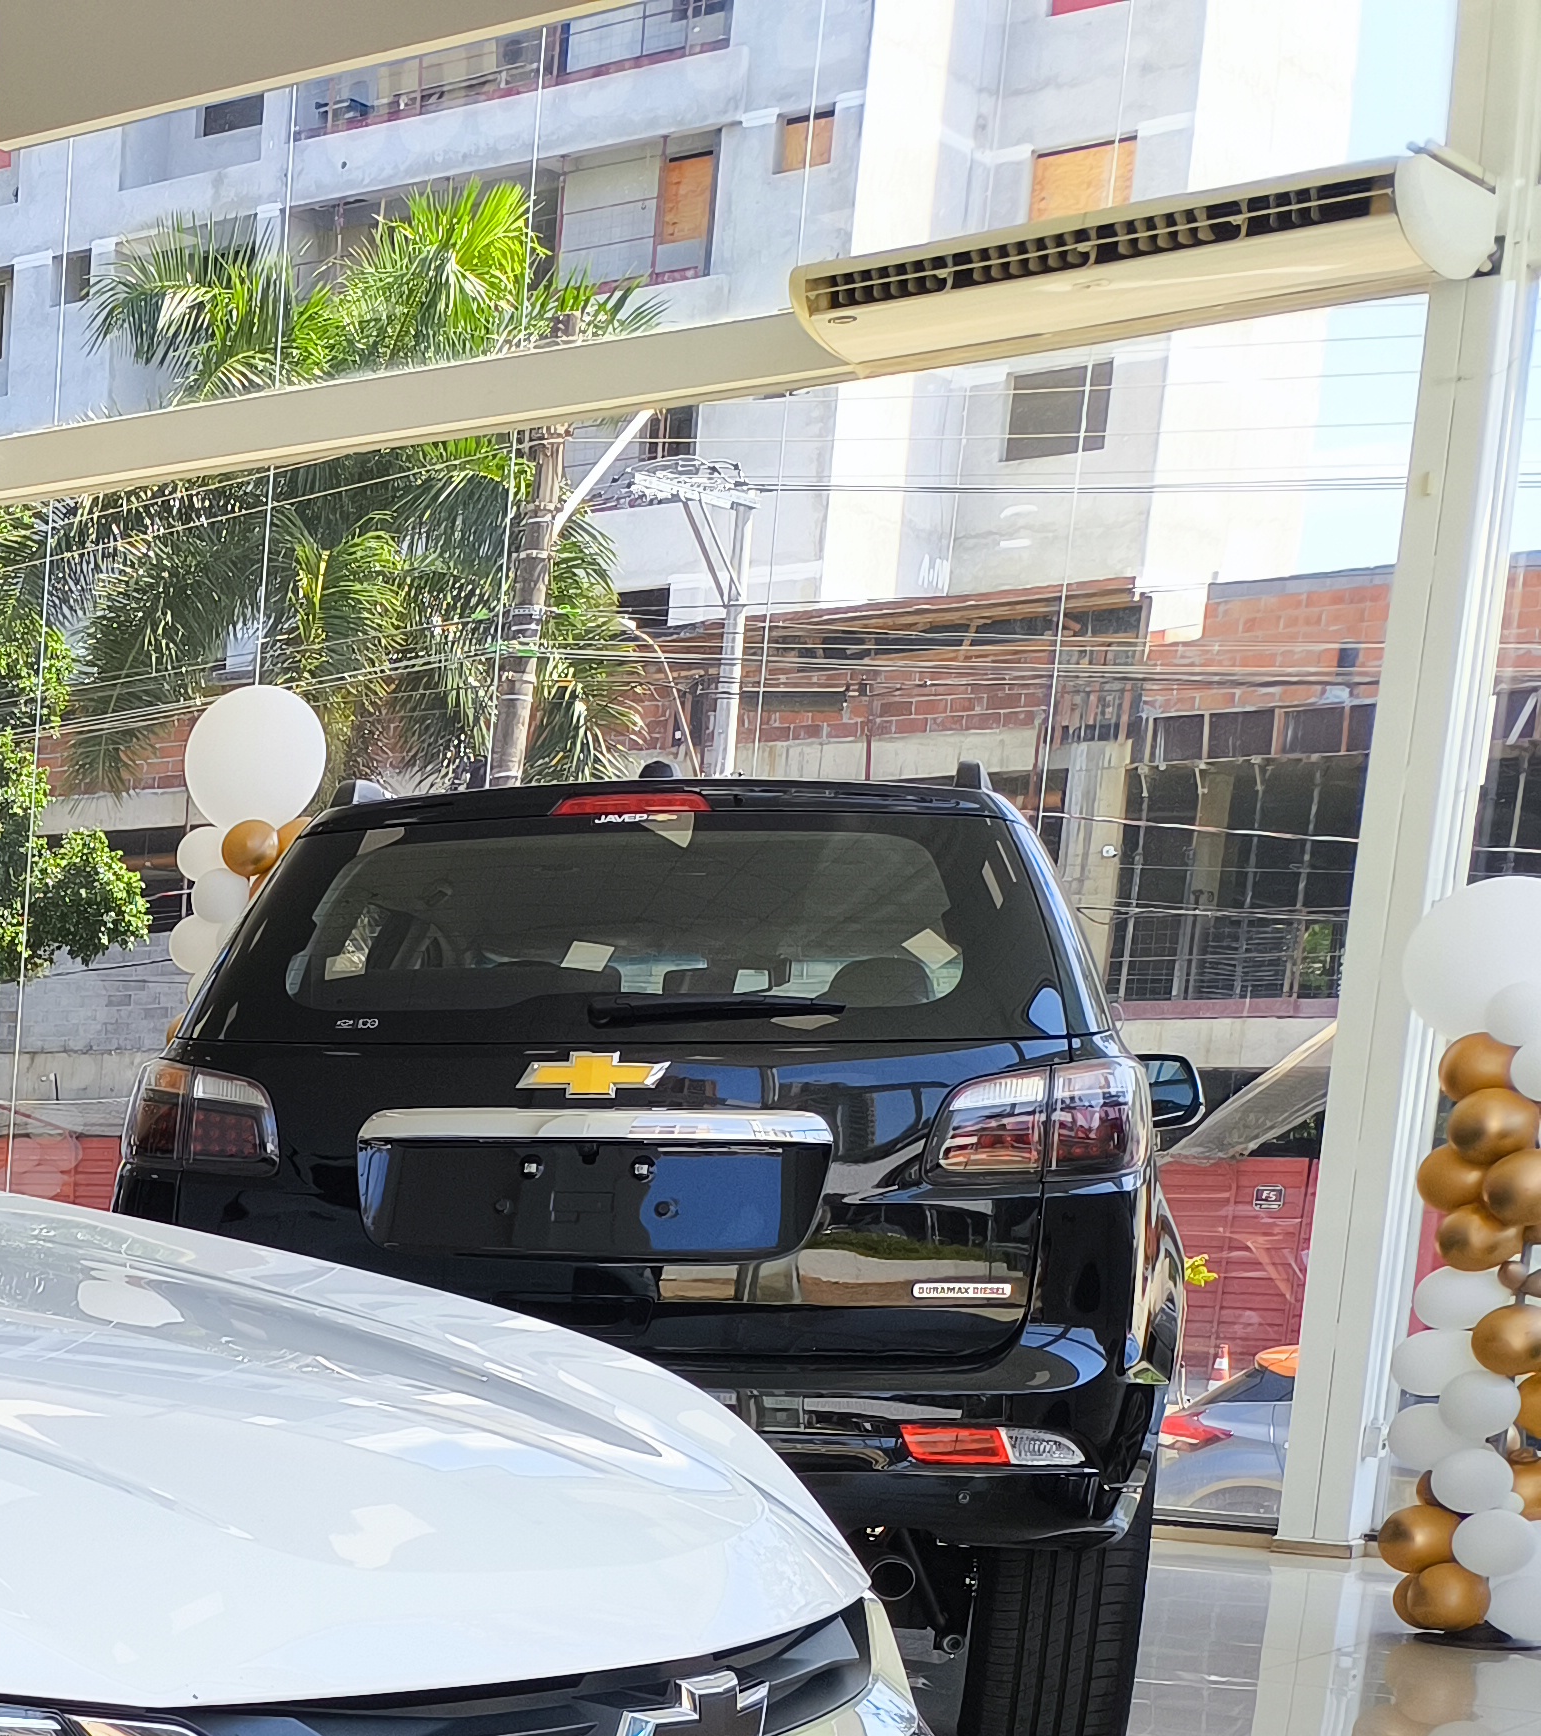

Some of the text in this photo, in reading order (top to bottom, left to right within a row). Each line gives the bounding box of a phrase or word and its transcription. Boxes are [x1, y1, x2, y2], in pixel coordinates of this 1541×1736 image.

[594, 813, 648, 824] JAVEP
[918, 1286, 1007, 1296] DURAMAX DIESEL
